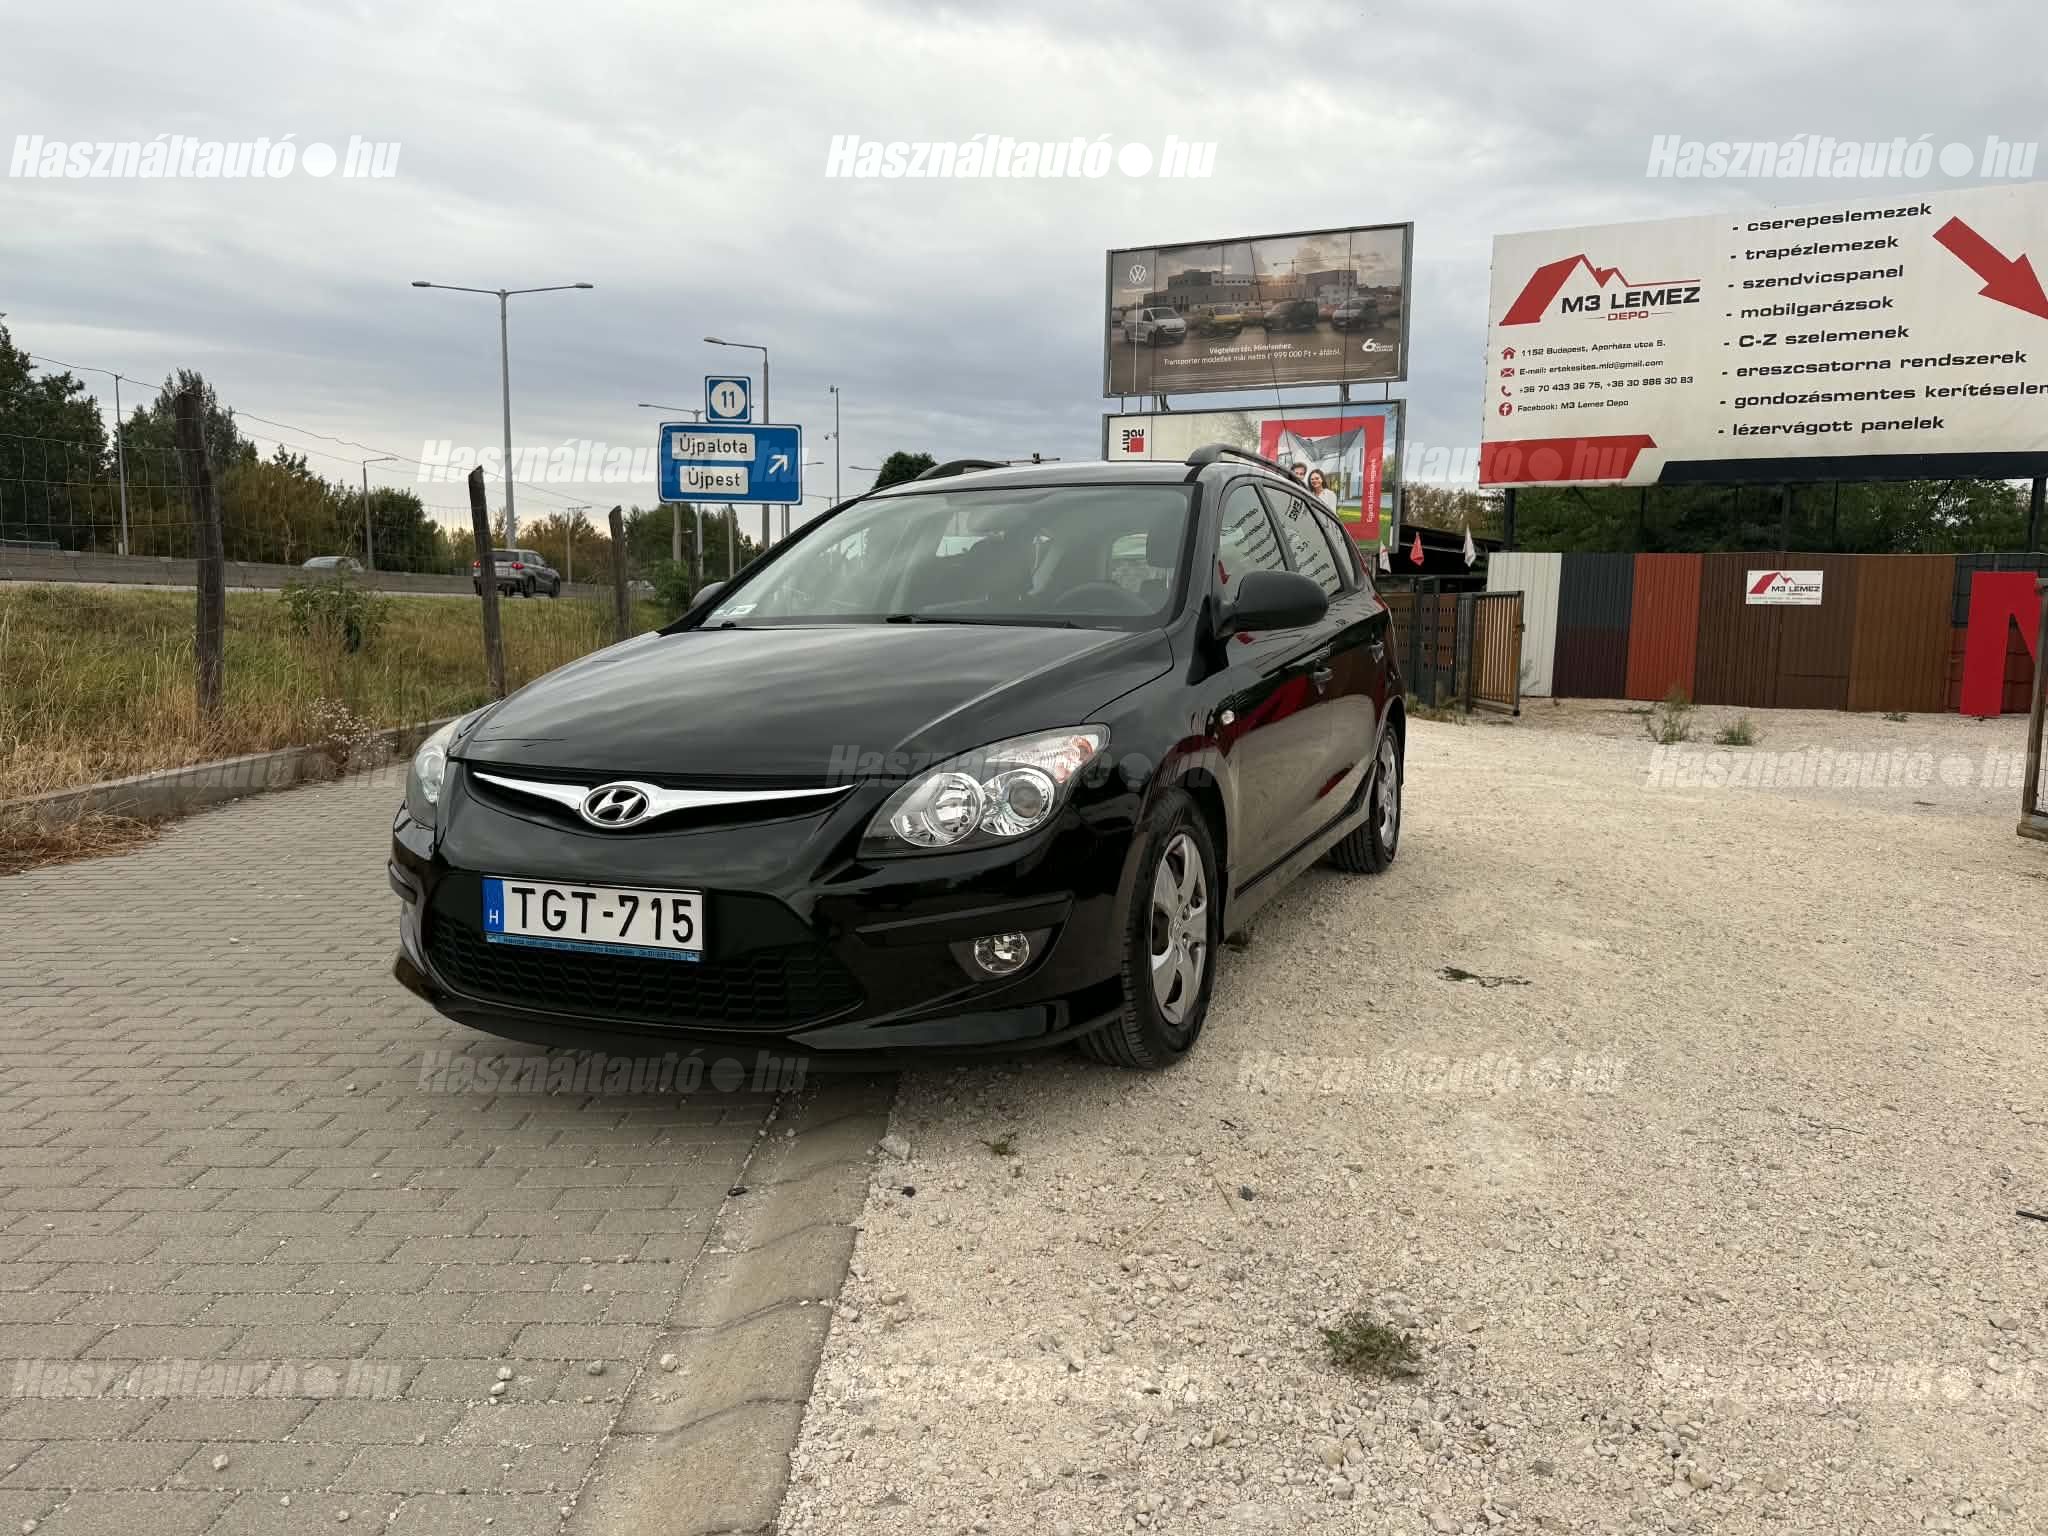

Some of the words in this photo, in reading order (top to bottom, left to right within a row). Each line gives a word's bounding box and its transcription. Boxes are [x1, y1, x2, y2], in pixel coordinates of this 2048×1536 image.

[1747, 203, 1933, 232] cserepeslemezek
[1745, 236, 1899, 260] trapézlemezek
[1743, 265, 1904, 289] szendvicspanel
[1561, 294, 1600, 313] M3
[1611, 287, 1701, 309] LEMEZ
[1740, 296, 1894, 319] mobilgarázsok
[1607, 310, 1649, 321] DEPO
[1739, 333, 1777, 348] C-Z
[1785, 325, 1910, 345] szelemenek
[1736, 359, 1891, 377] ereszcsatorna
[1900, 350, 2028, 368] rendszerek
[721, 390, 736, 409] 11
[1734, 388, 1916, 409] gondozásmentes
[1733, 421, 1853, 436] lézervágott
[1861, 416, 1944, 434] panelek
[679, 432, 748, 456] Újpalota
[687, 467, 741, 489] Újpest
[489, 909, 499, 925] H
[511, 887, 694, 943] TGT-715
